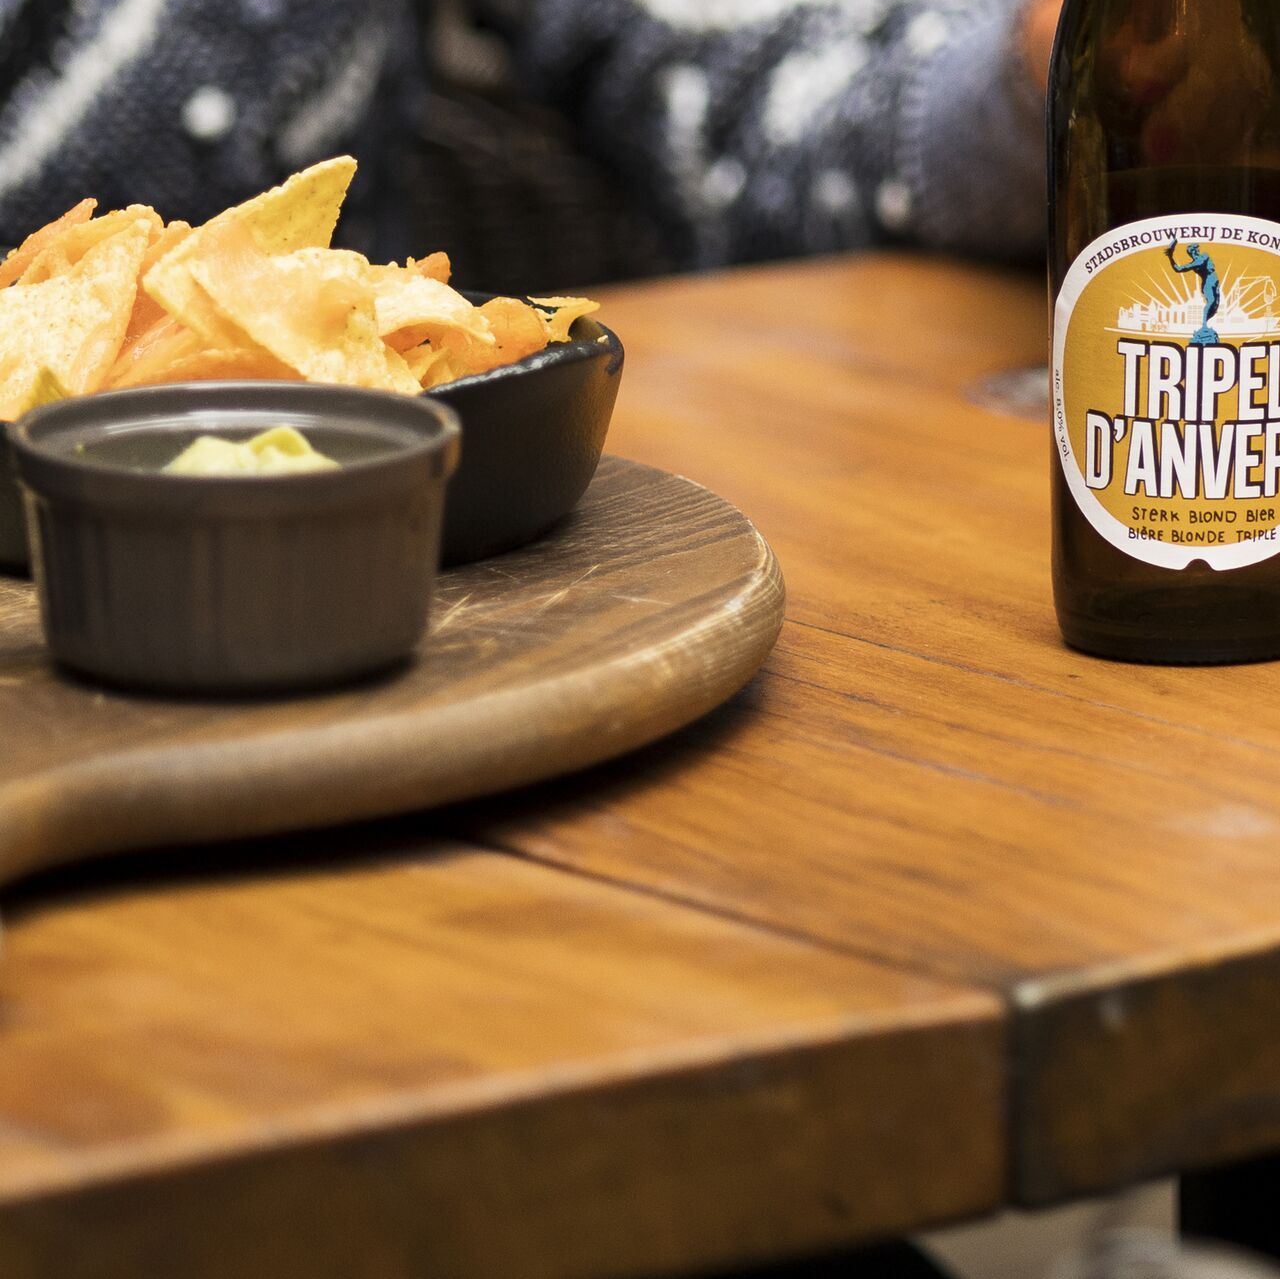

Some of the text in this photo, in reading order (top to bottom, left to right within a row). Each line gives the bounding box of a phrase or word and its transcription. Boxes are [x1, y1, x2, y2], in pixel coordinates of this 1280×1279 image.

[1085, 226, 1216, 274] STADSBROUWERIJ
[1221, 226, 1244, 241] DE
[1060, 435, 1070, 462] vol.
[1189, 510, 1237, 524] BLOND
[1171, 529, 1225, 543] BLONDE
[1236, 527, 1277, 543] TRIPLE
